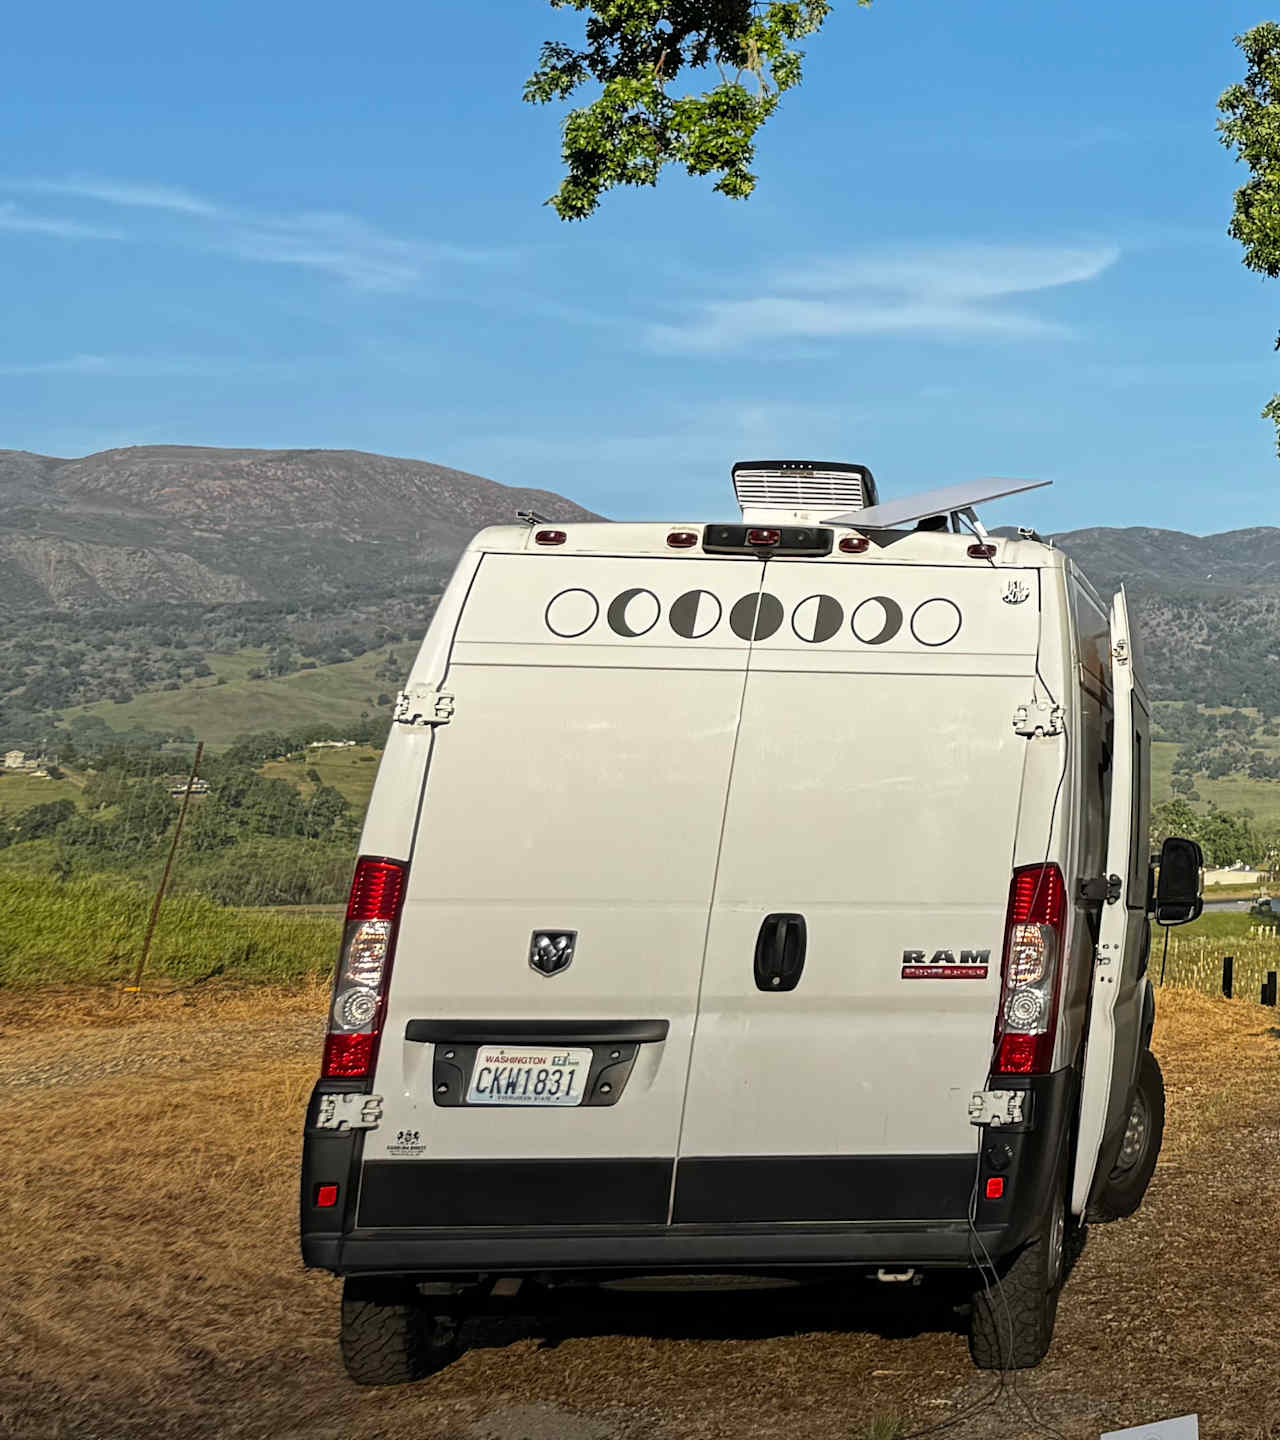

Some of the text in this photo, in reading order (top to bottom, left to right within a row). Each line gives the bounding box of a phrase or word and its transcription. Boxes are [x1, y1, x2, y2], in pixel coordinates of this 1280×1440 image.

[903, 950, 991, 964] RAM
[485, 1055, 548, 1065] WASHINGTON
[475, 1066, 576, 1096] CKW1831
